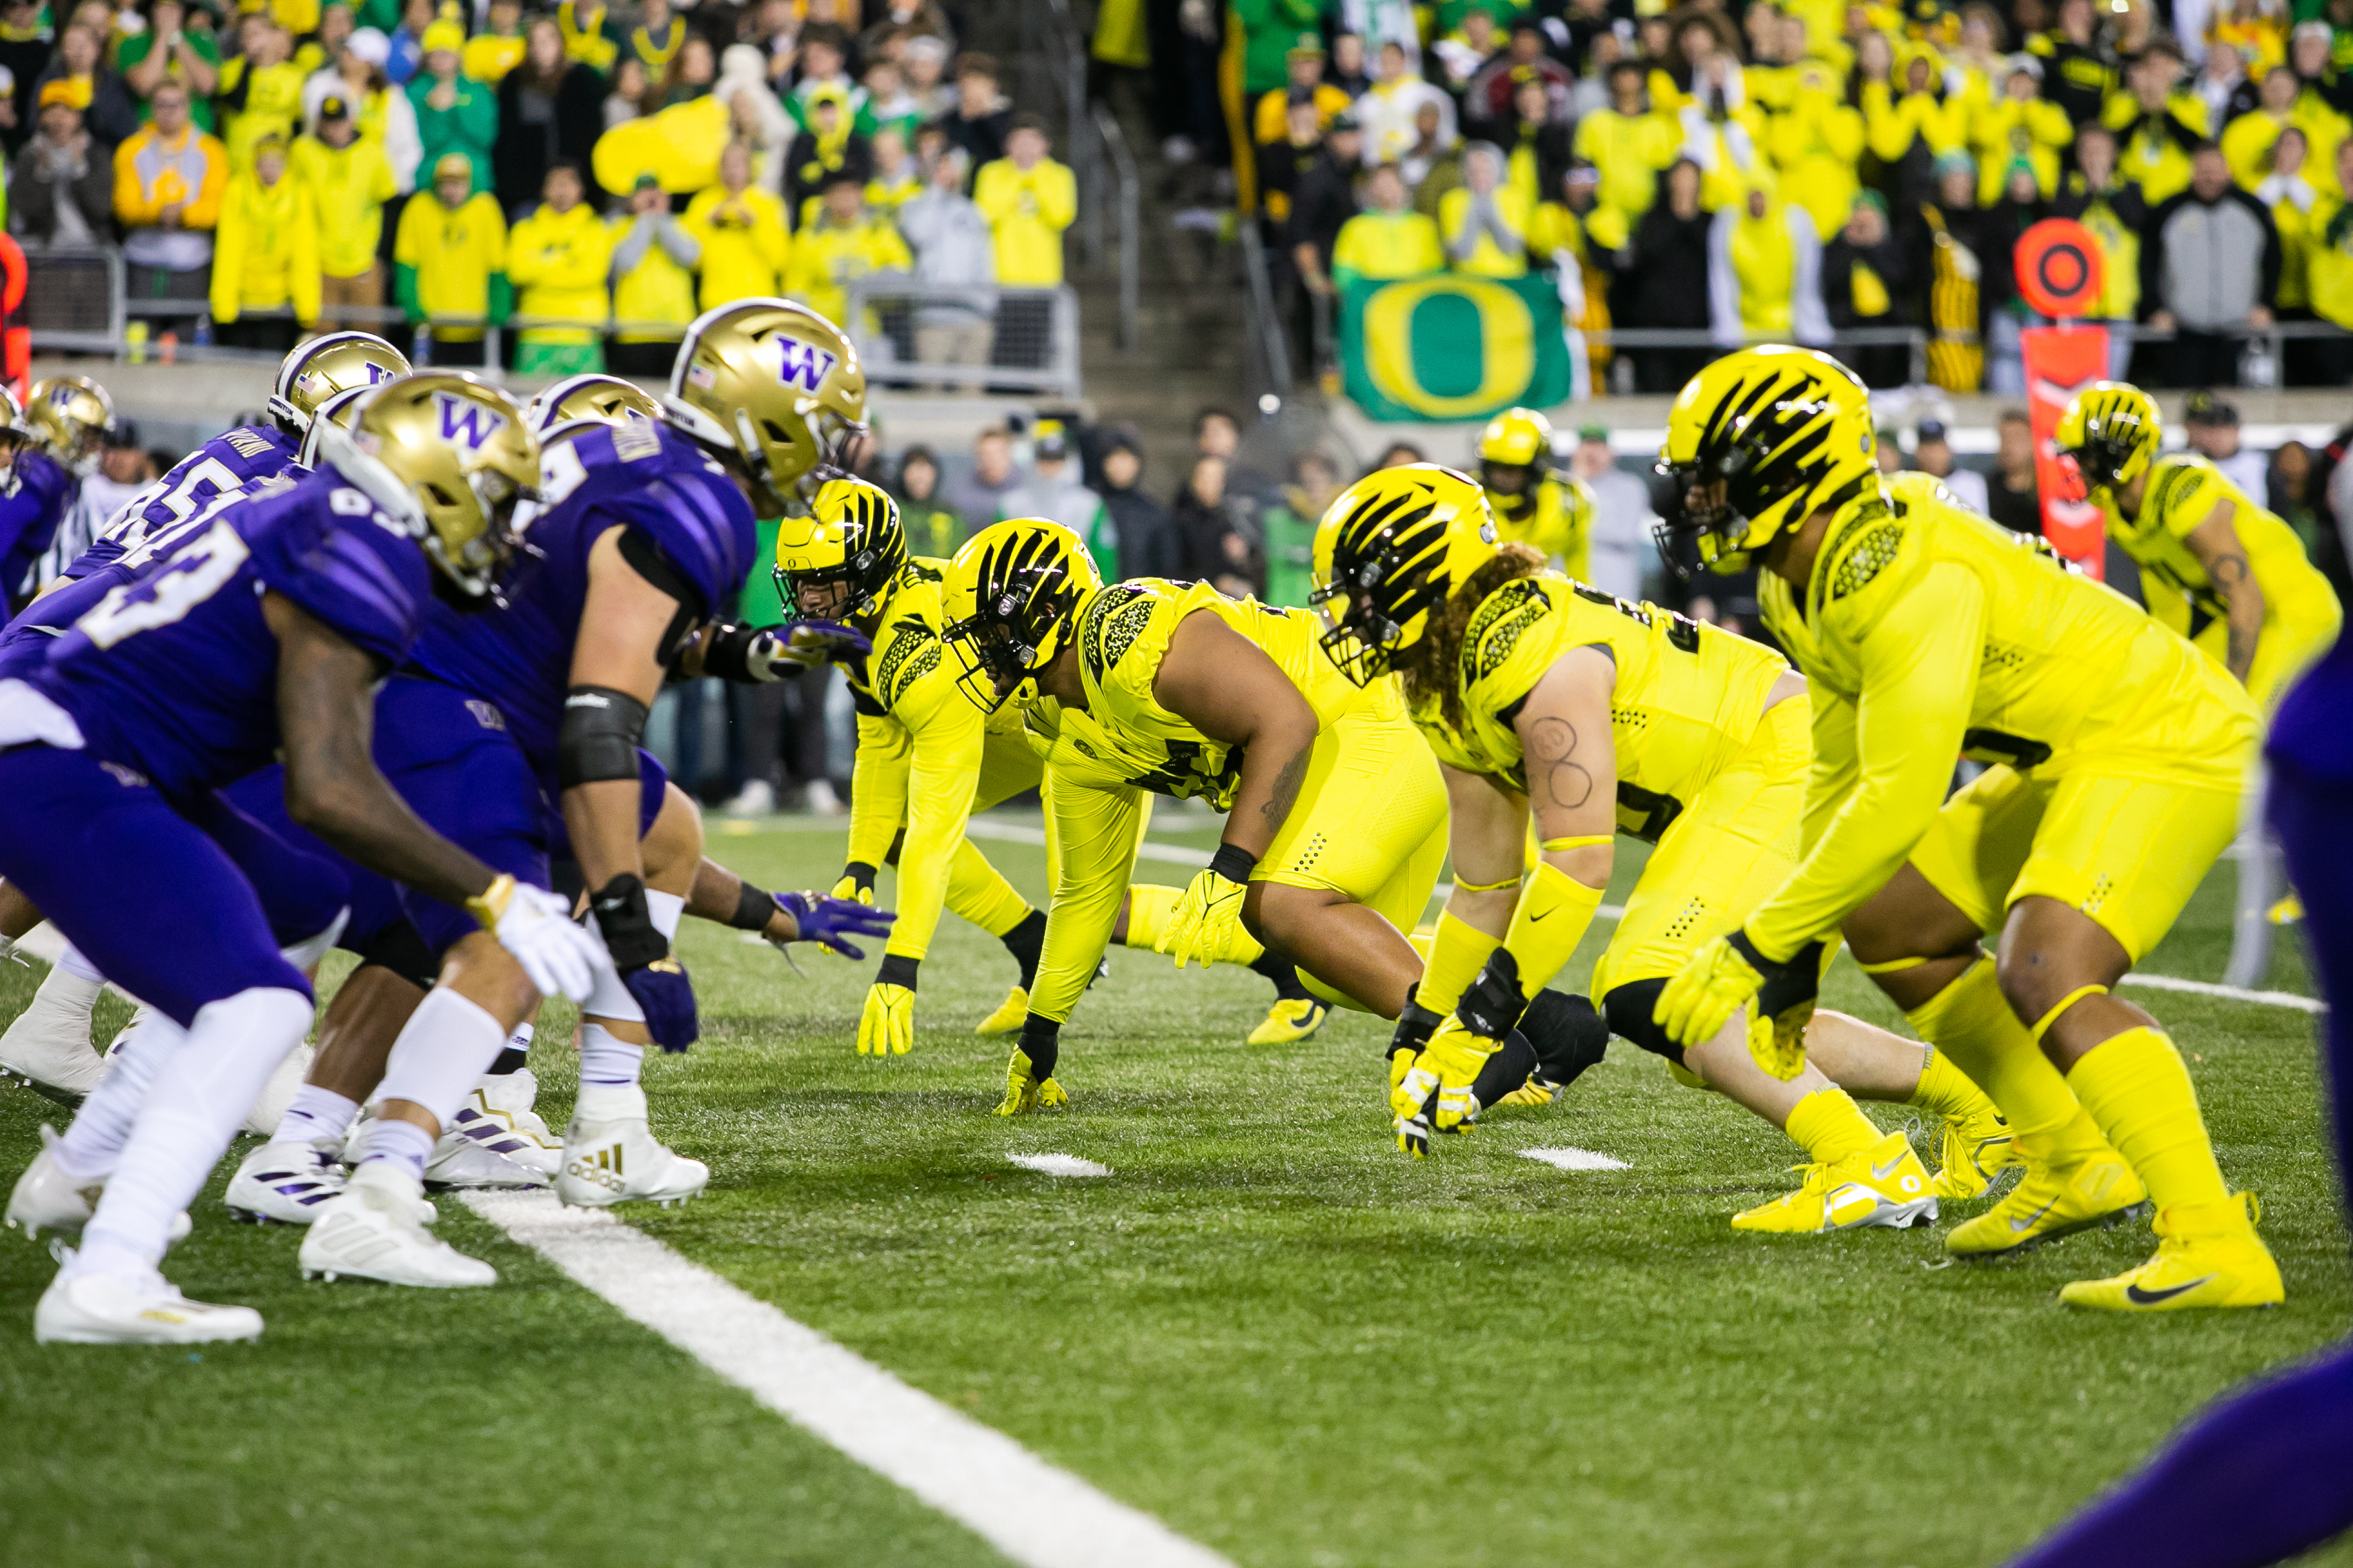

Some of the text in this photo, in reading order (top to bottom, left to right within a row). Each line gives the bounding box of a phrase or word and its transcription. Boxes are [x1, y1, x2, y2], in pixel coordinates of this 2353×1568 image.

[774, 333, 838, 396] W
[1363, 278, 1538, 417] O
[434, 392, 506, 453] W
[567, 1163, 626, 1194] adidas
